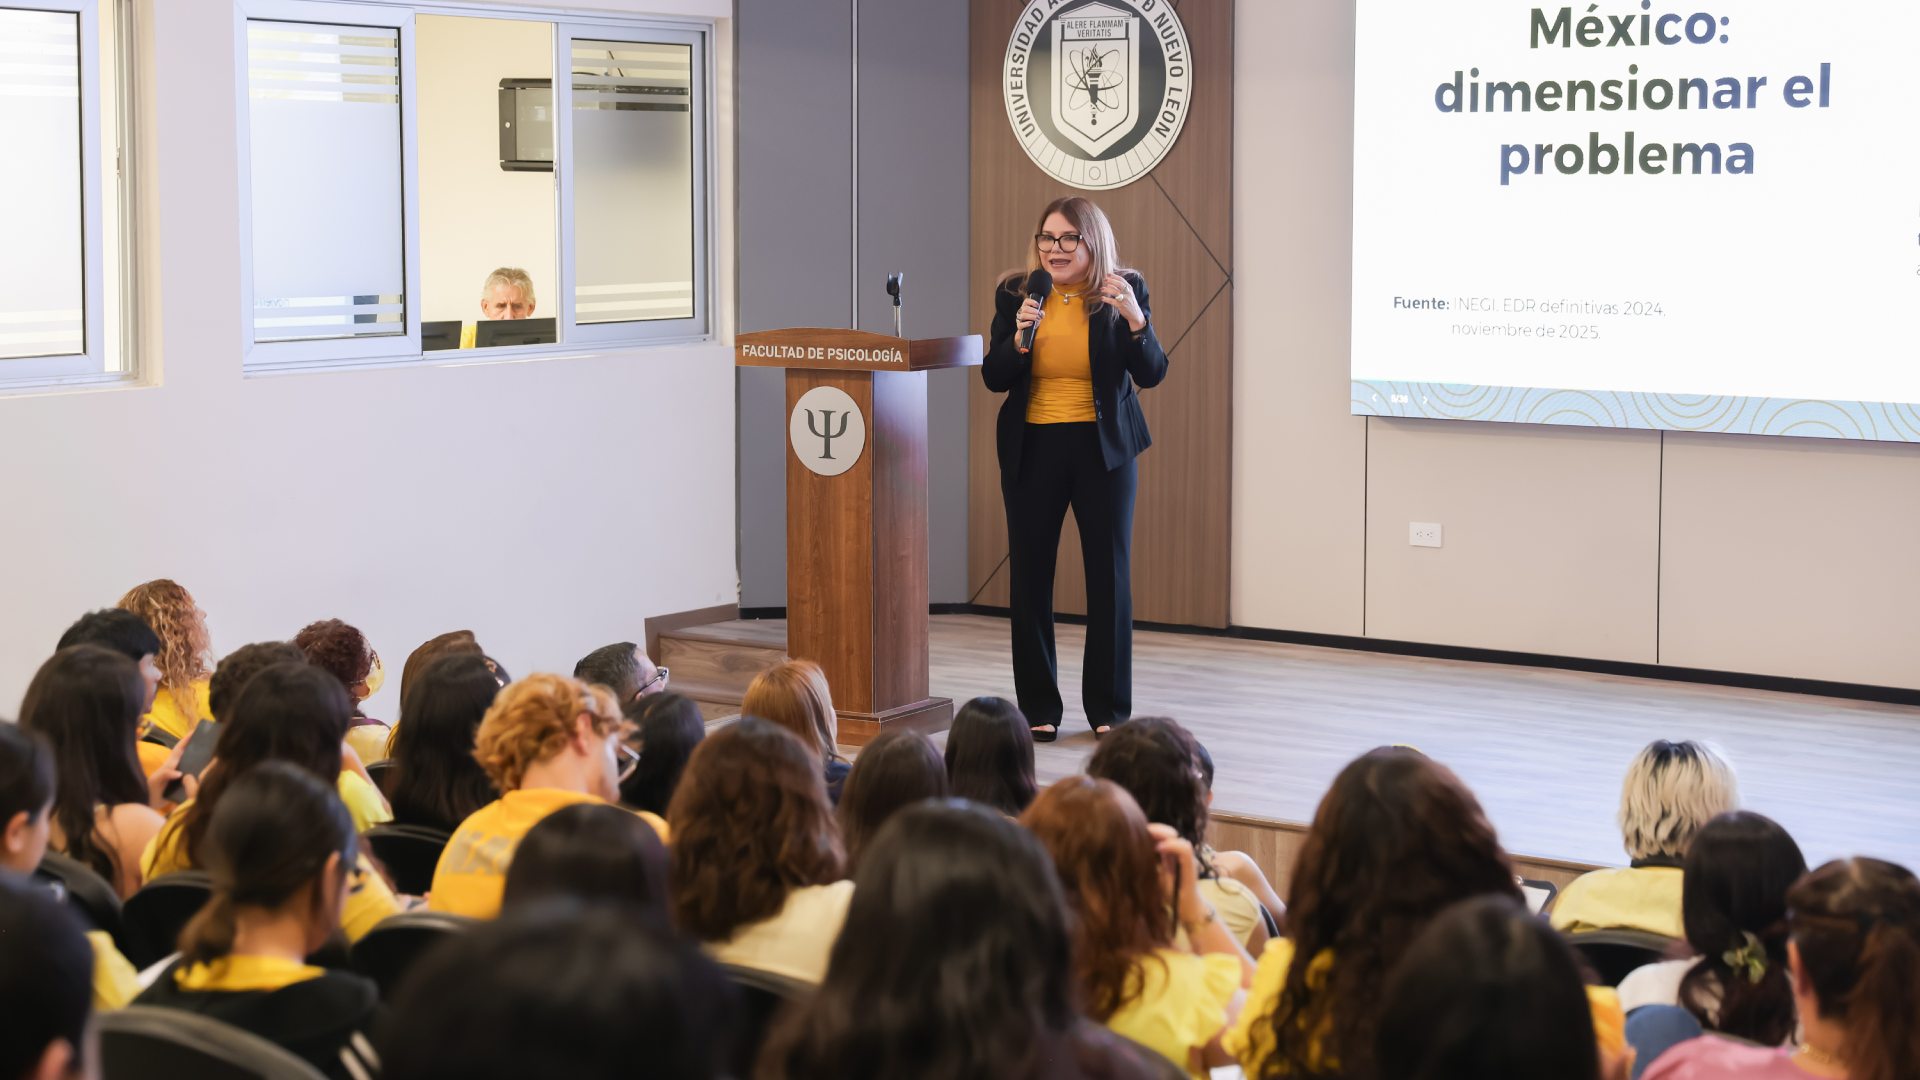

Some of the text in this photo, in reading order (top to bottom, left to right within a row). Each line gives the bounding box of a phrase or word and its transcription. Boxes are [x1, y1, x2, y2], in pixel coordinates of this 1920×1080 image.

[1066, 19, 1124, 29] ALERE FLAMMAM
[1077, 29, 1112, 38] VERITATIS
[1153, 12, 1184, 78] NUEVO
[1530, 0, 1730, 49] México:
[1010, 8, 1044, 138] UNIVERSIDAD
[1434, 62, 1831, 113] dimensionar el
[1154, 87, 1183, 138] LEON
[1500, 130, 1755, 186] problema
[1393, 296, 1450, 311] Fuente:
[1504, 297, 1536, 312] EDR
[1539, 298, 1619, 315] definitivas
[742, 344, 904, 363] FACULTAD DE PSICOLOGÍA
[1452, 321, 1601, 340] noviembre de 2025.
